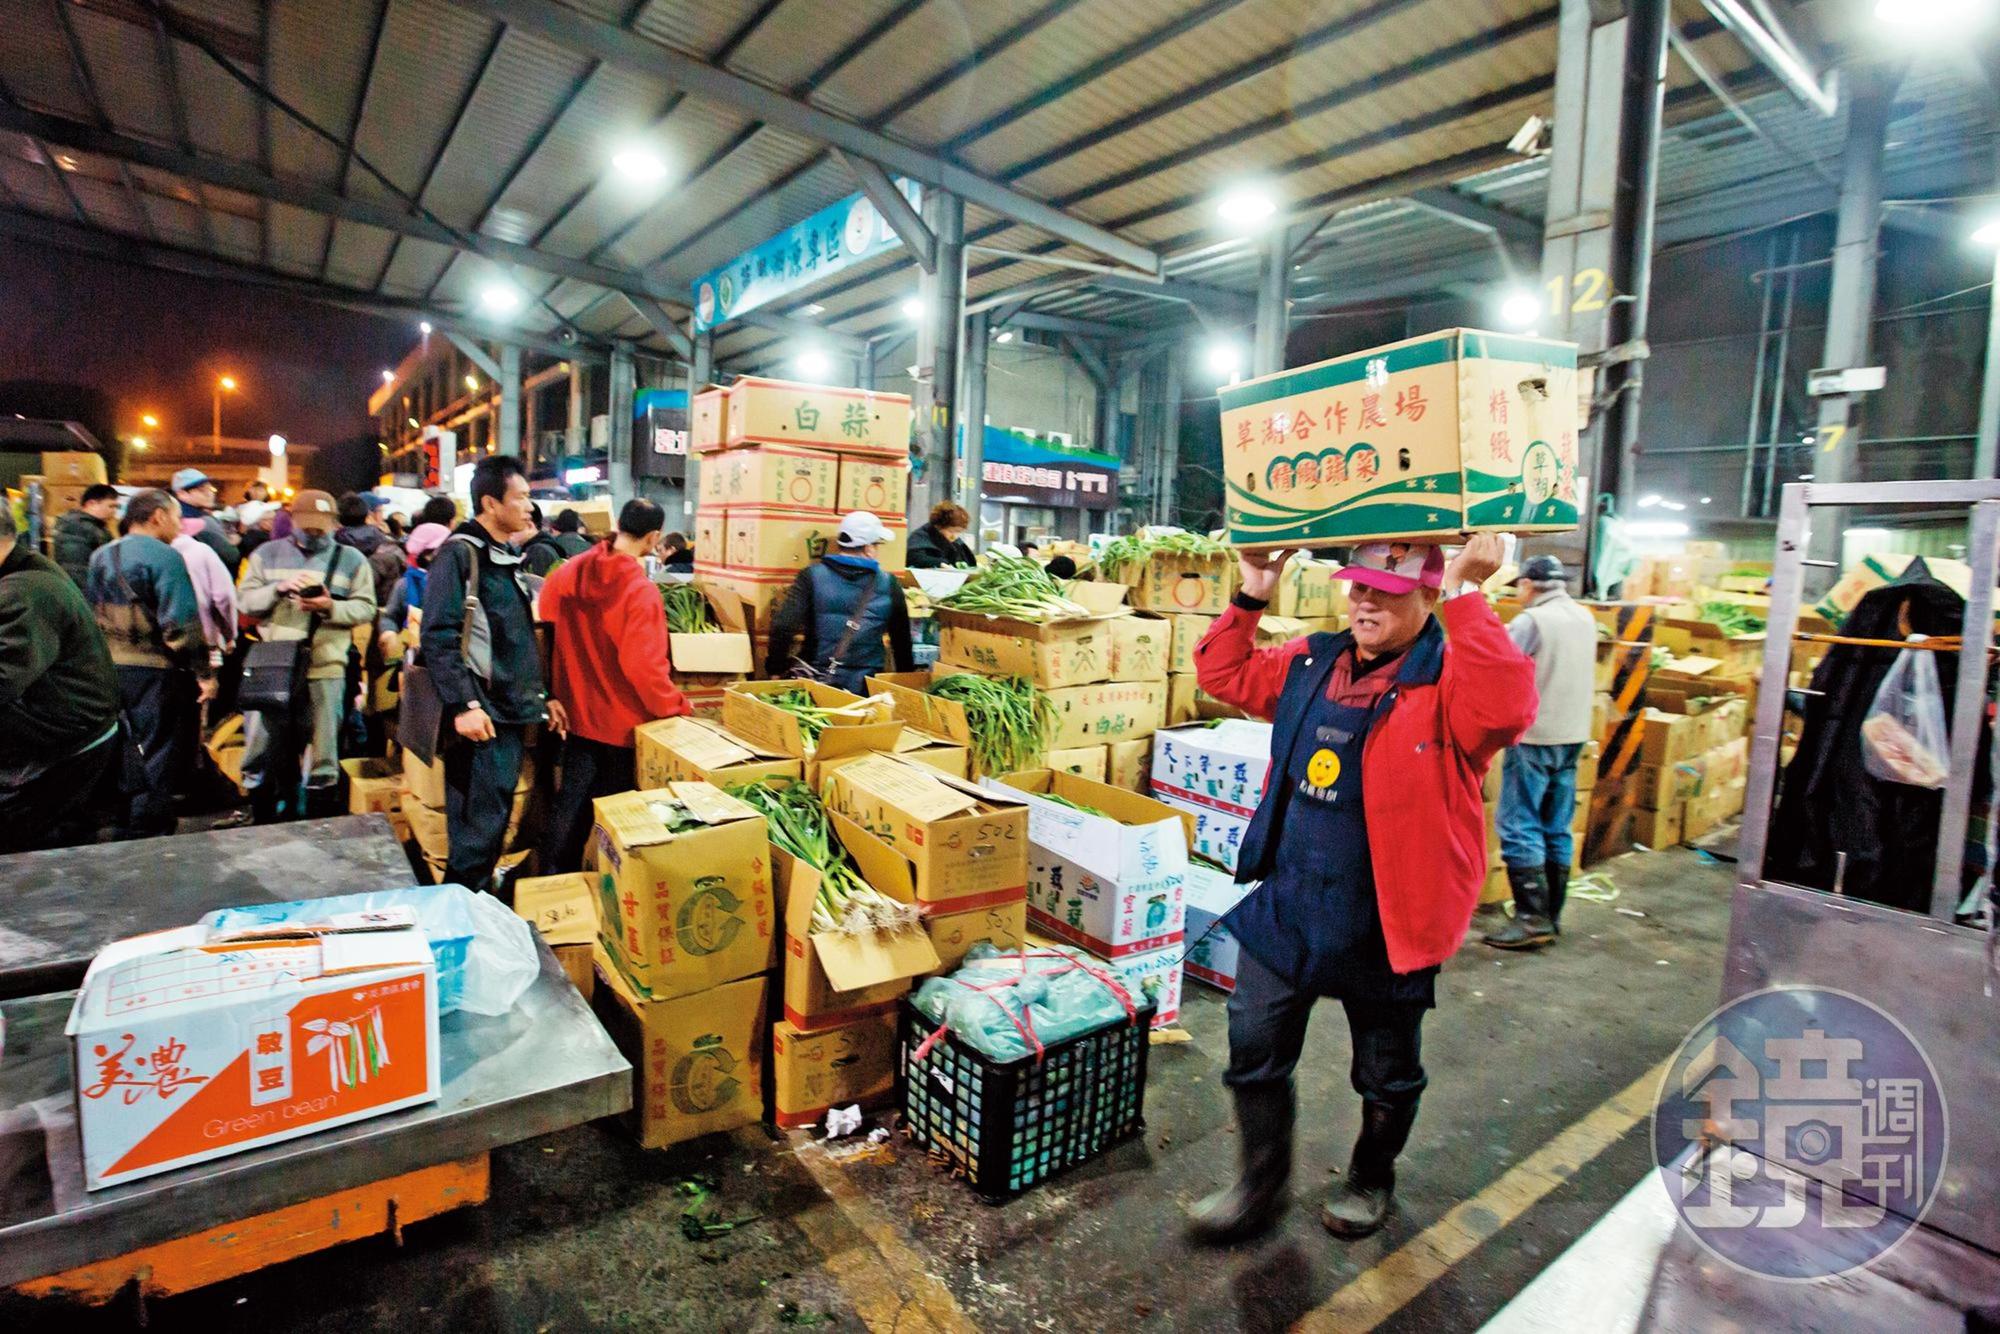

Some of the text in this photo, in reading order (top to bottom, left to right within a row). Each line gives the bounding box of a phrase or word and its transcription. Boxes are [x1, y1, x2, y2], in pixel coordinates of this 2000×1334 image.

[1545, 267, 1606, 316] 12
[794, 401, 869, 438] 白蒜
[1236, 384, 1429, 451] 草湖合作農場
[1489, 387, 1513, 463] 精緻
[1821, 425, 1846, 453] 7
[1270, 450, 1380, 493] 精緻蔬菜
[1532, 450, 1550, 498] 草湖
[976, 822, 1019, 841] 502
[81, 1032, 210, 1106] 美濃
[256, 1031, 285, 1093] 敏豆
[202, 1094, 337, 1139] Green bean
